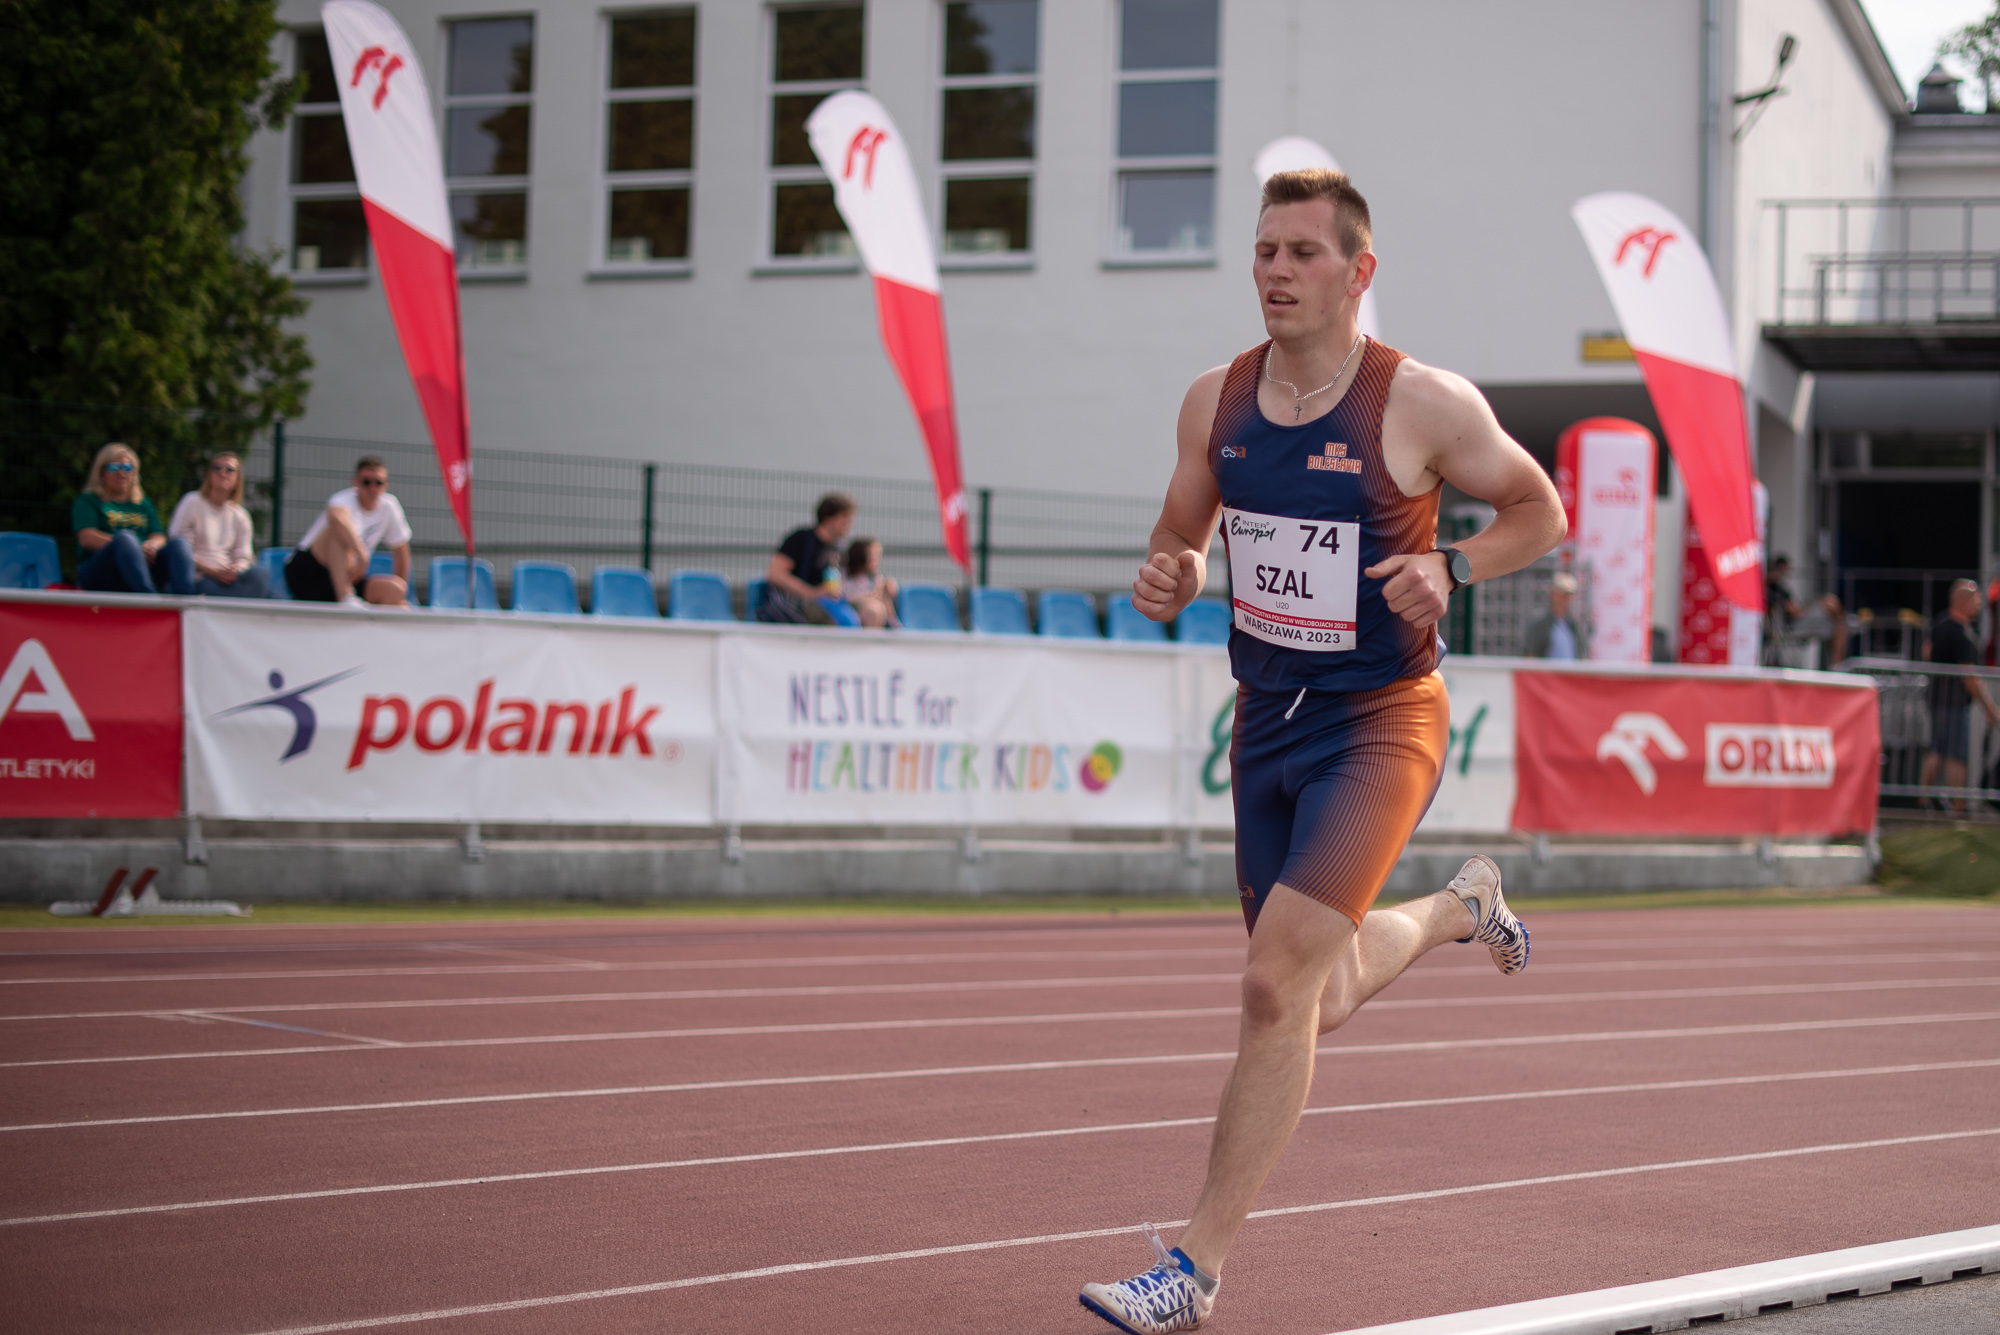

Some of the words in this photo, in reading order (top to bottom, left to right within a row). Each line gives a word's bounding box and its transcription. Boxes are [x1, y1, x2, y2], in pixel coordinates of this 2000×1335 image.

[1325, 442, 1348, 457] MKS
[1230, 515, 1276, 544] Europol
[1242, 520, 1267, 529] INTER
[1300, 524, 1340, 555] 74
[1256, 564, 1313, 599] SZAL
[1275, 601, 1290, 610] U20
[1243, 613, 1303, 641] WARSZAWA
[1306, 631, 1341, 644] 2023
[914, 684, 958, 727] for
[345, 677, 662, 774] polanik
[0, 758, 95, 779] TLETYKI
[787, 740, 981, 794] HEALTHIER
[994, 742, 1070, 793] KIDS
